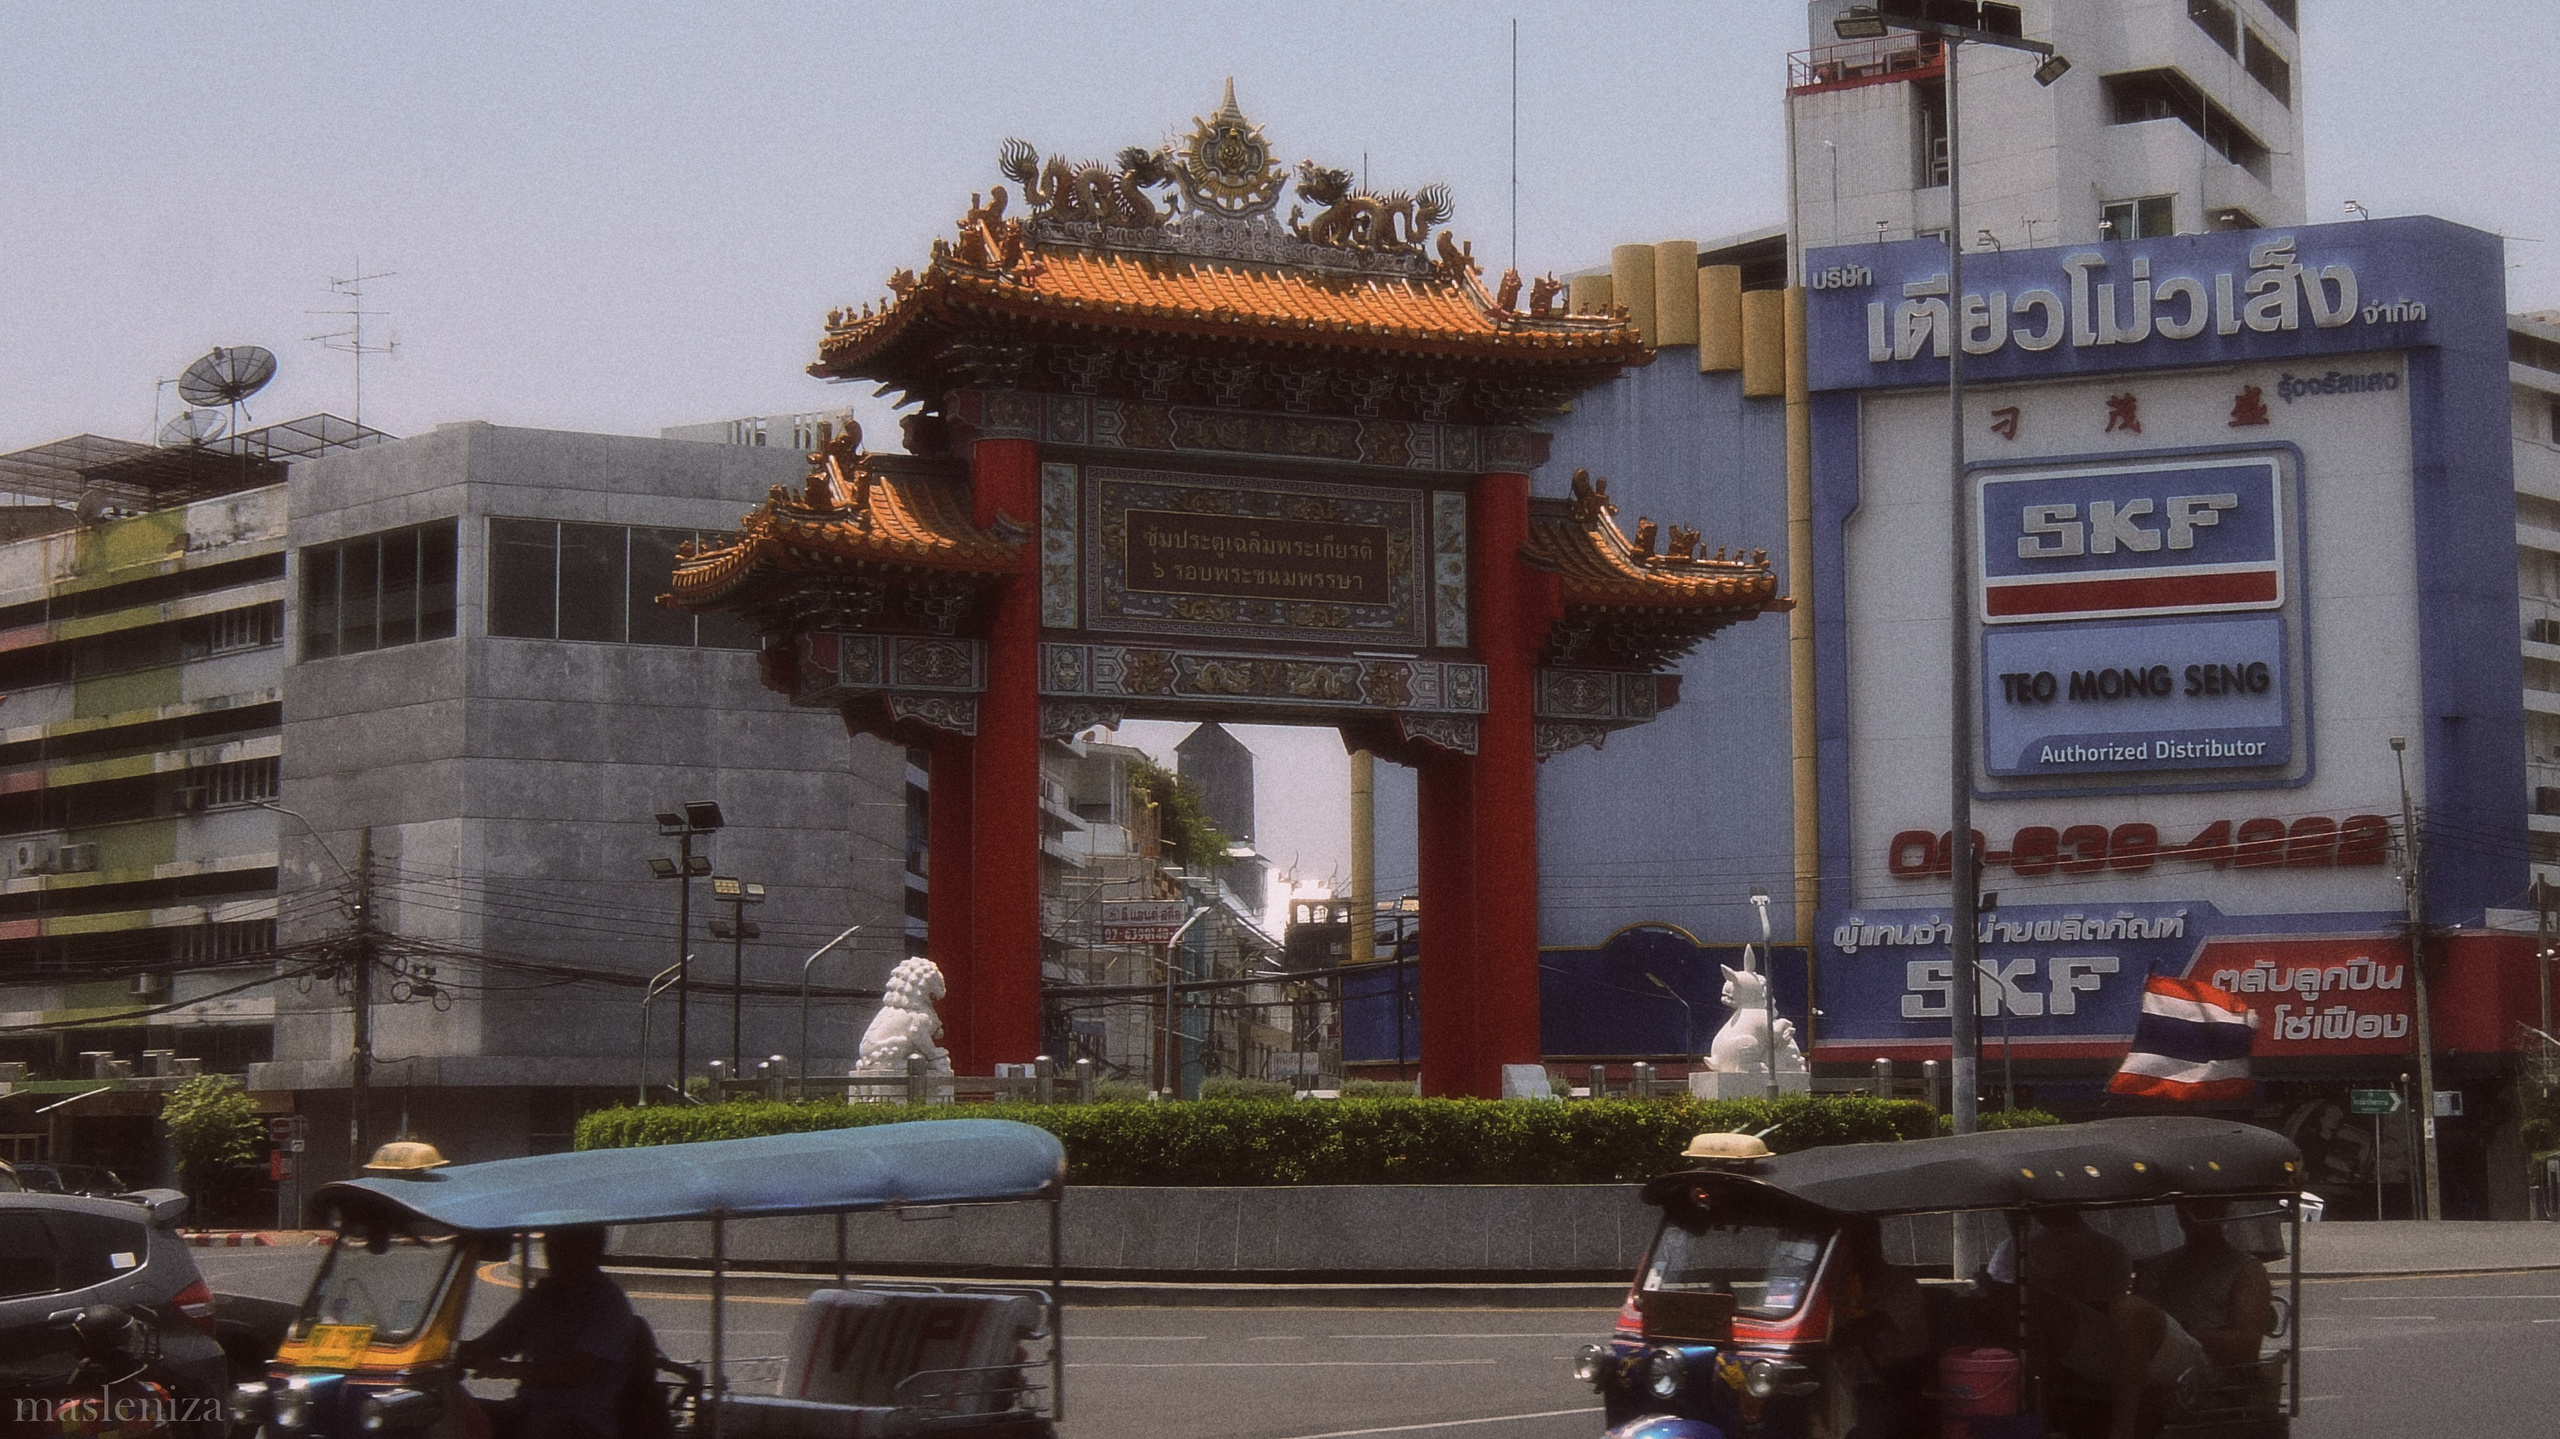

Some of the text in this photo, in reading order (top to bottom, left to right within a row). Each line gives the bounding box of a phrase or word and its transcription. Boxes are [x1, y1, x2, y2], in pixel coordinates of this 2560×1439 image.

[1812, 263, 1872, 290] บริษัท
[2361, 296, 2426, 325] จำกัด
[2017, 492, 2238, 559] SKF
[1173, 563, 1364, 590] รอบพระชนมพรรษา
[1999, 661, 2271, 704] TEO MONG SENG
[2040, 738, 2267, 764] Authorized Distributor
[1833, 909, 2187, 954] ผู้แทนจำน่ายผลิตภัณฑ์
[1901, 956, 2120, 1018] SKF
[2211, 956, 2404, 1002] ตลับลูกปืน
[830, 1304, 969, 1377] VIP
